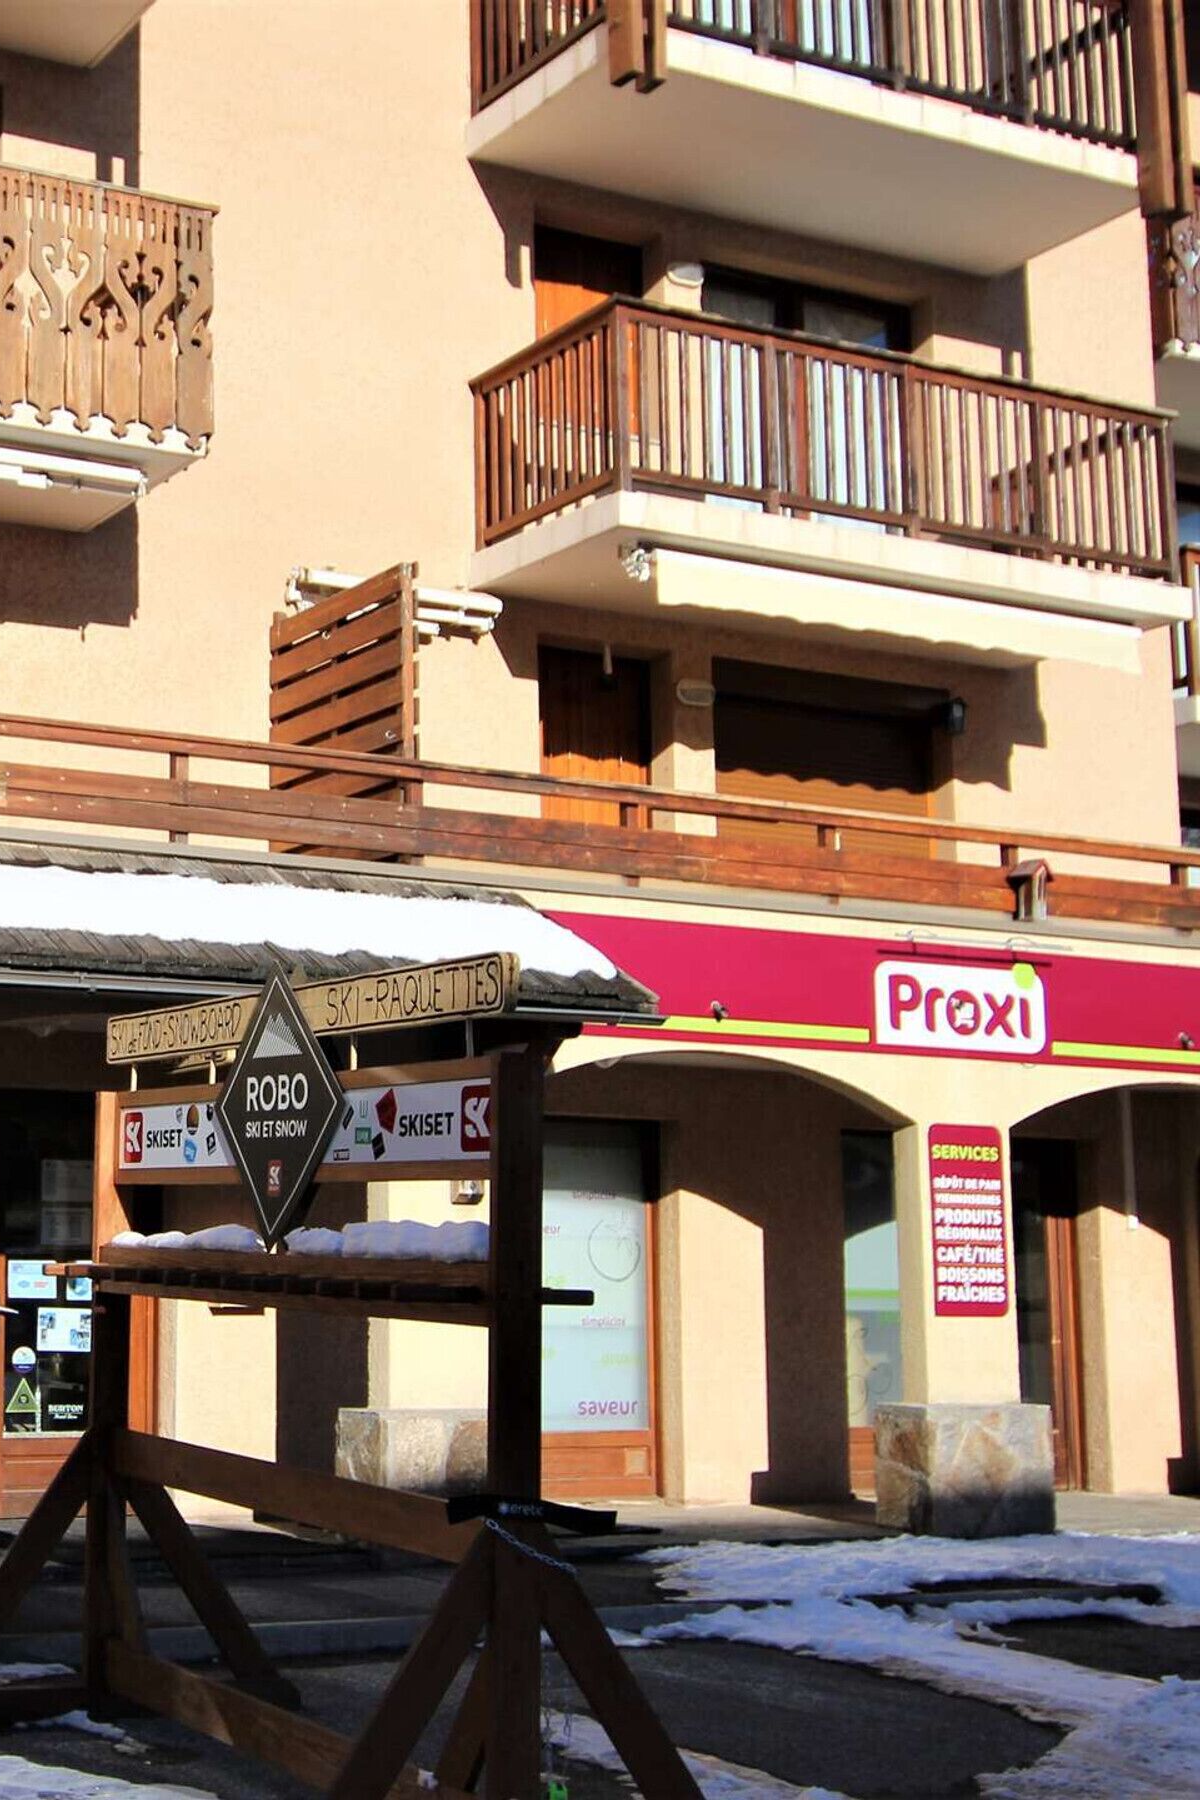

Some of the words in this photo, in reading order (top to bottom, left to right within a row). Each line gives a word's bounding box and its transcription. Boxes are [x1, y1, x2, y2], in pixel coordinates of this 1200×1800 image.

[888, 964, 1035, 1040] Proxi
[246, 1072, 309, 1112] ROBO
[245, 1121, 261, 1138] SKI
[263, 1120, 274, 1138] ET
[275, 1119, 308, 1137] SNOW
[398, 1112, 454, 1137] SKISET
[146, 1129, 183, 1149] SKISET
[932, 1144, 999, 1162] SERVICES
[935, 1208, 1003, 1224] PRODUITS
[936, 1222, 1003, 1241] RÉGIONAUX
[936, 1242, 1004, 1263] CAFÉ/THÉ
[937, 1266, 1005, 1283] BOISSONS
[938, 1282, 1006, 1303] FRAÎCHES
[577, 1400, 639, 1416] saveur
